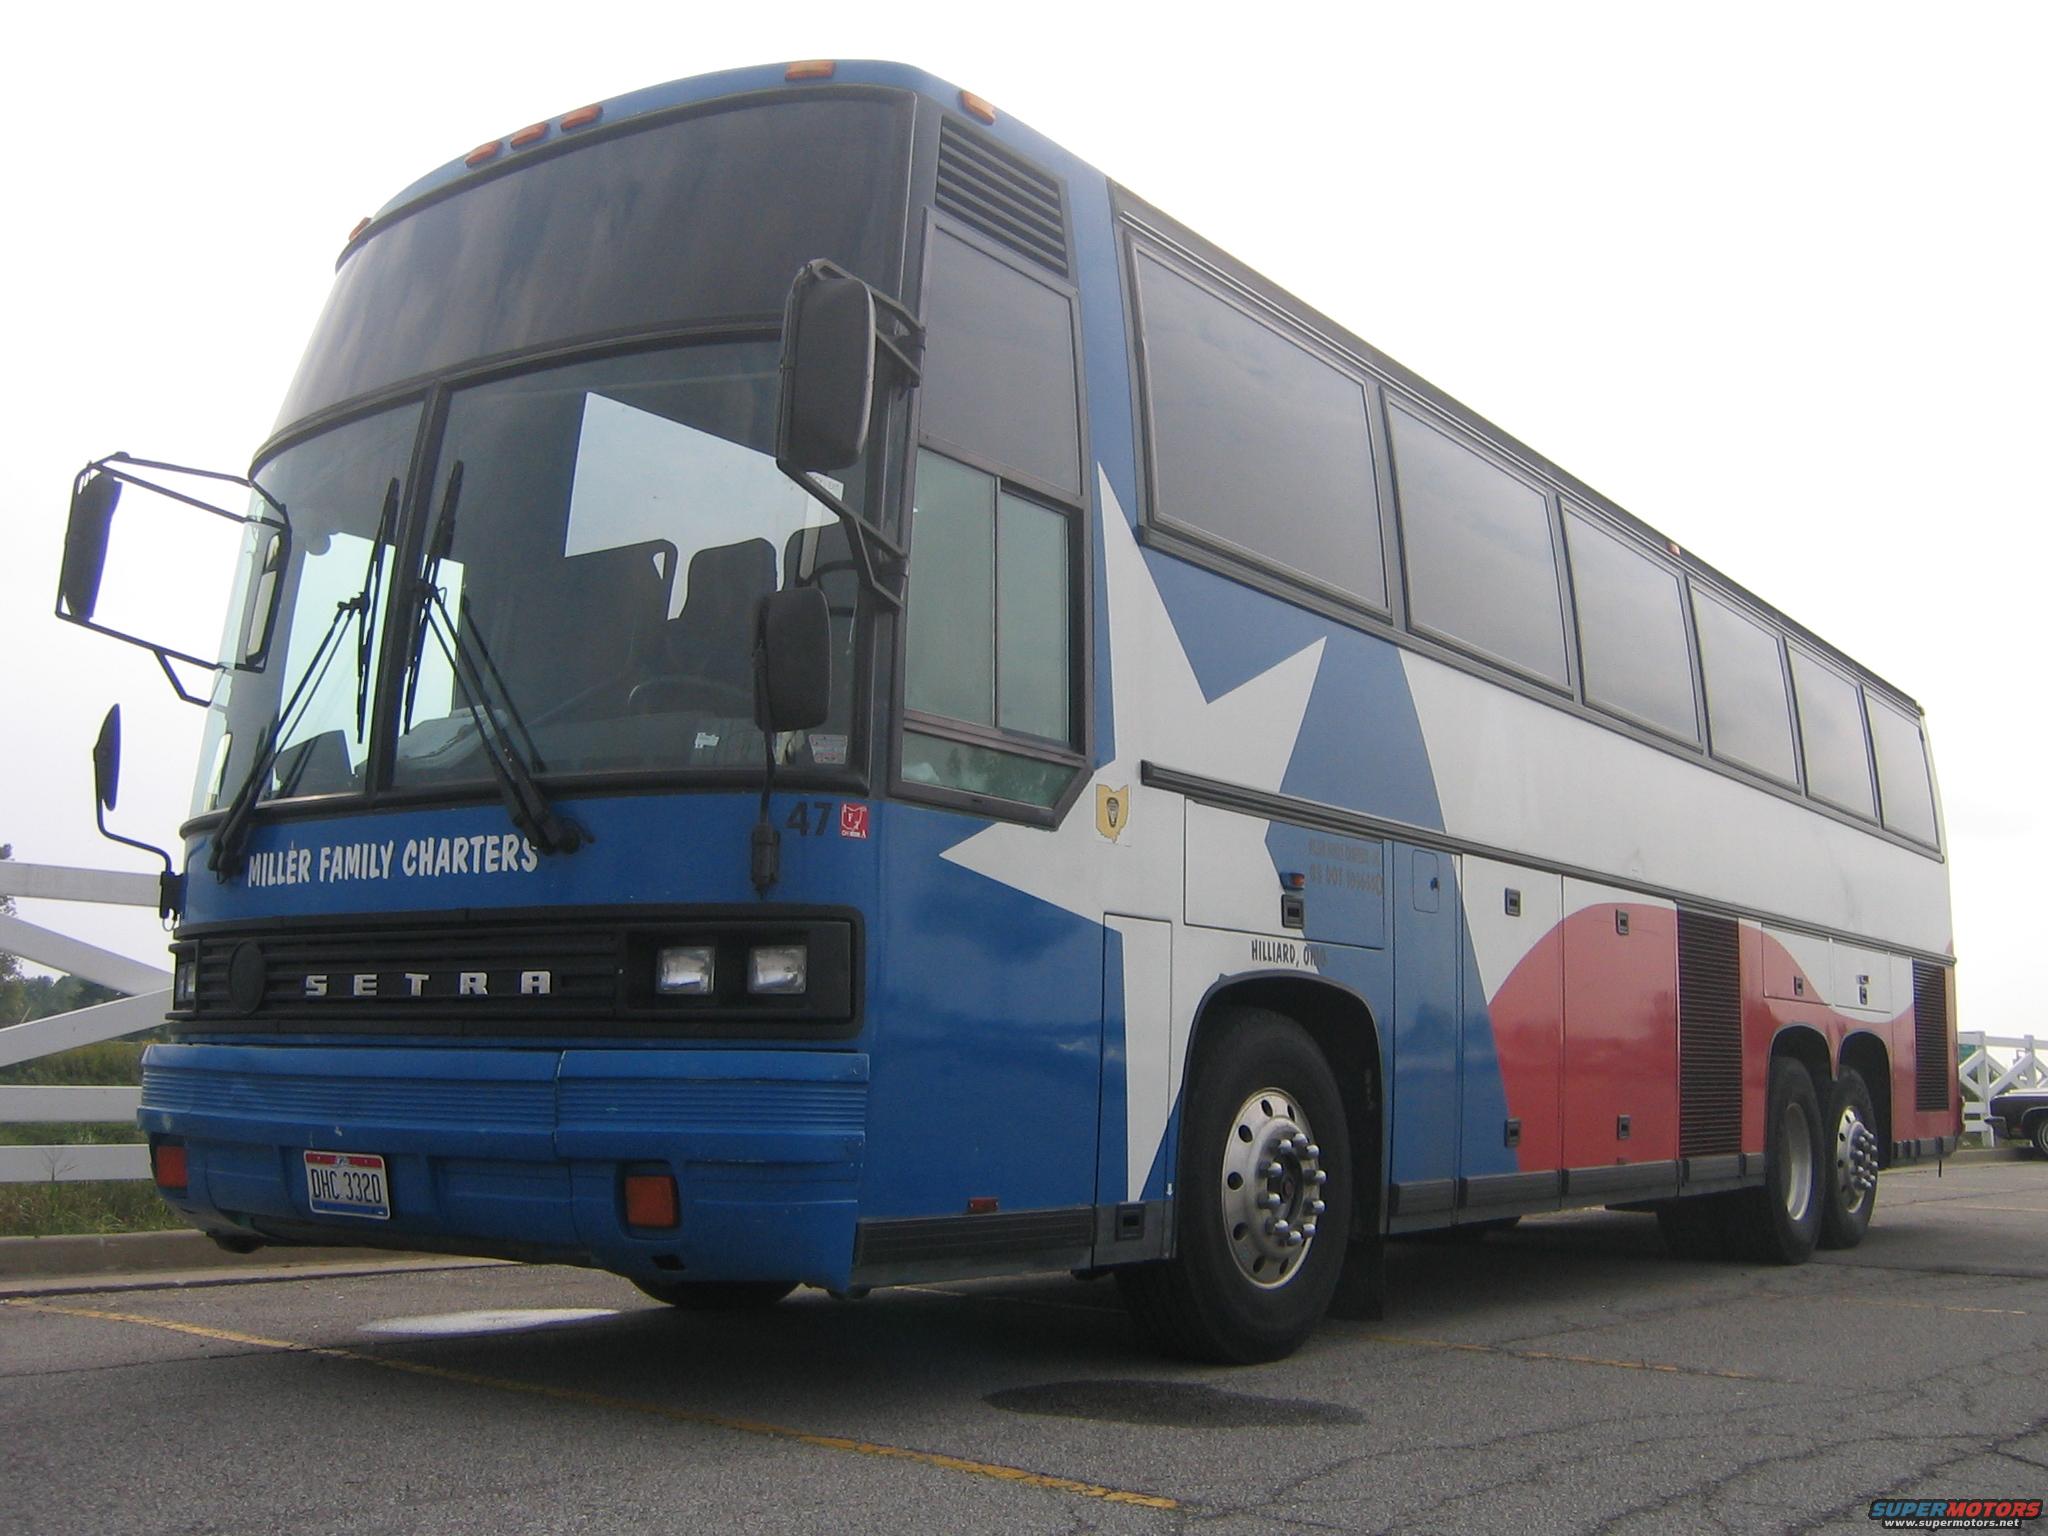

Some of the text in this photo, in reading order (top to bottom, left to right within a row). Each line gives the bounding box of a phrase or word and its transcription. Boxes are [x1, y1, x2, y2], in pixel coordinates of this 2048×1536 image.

[785, 801, 832, 836] 47
[247, 833, 538, 888] MILLER FAMILY CHARTERS
[1251, 939, 1299, 968] HILLIARD,
[305, 970, 551, 996] SETRA
[311, 1169, 382, 1203] DHC 3320
